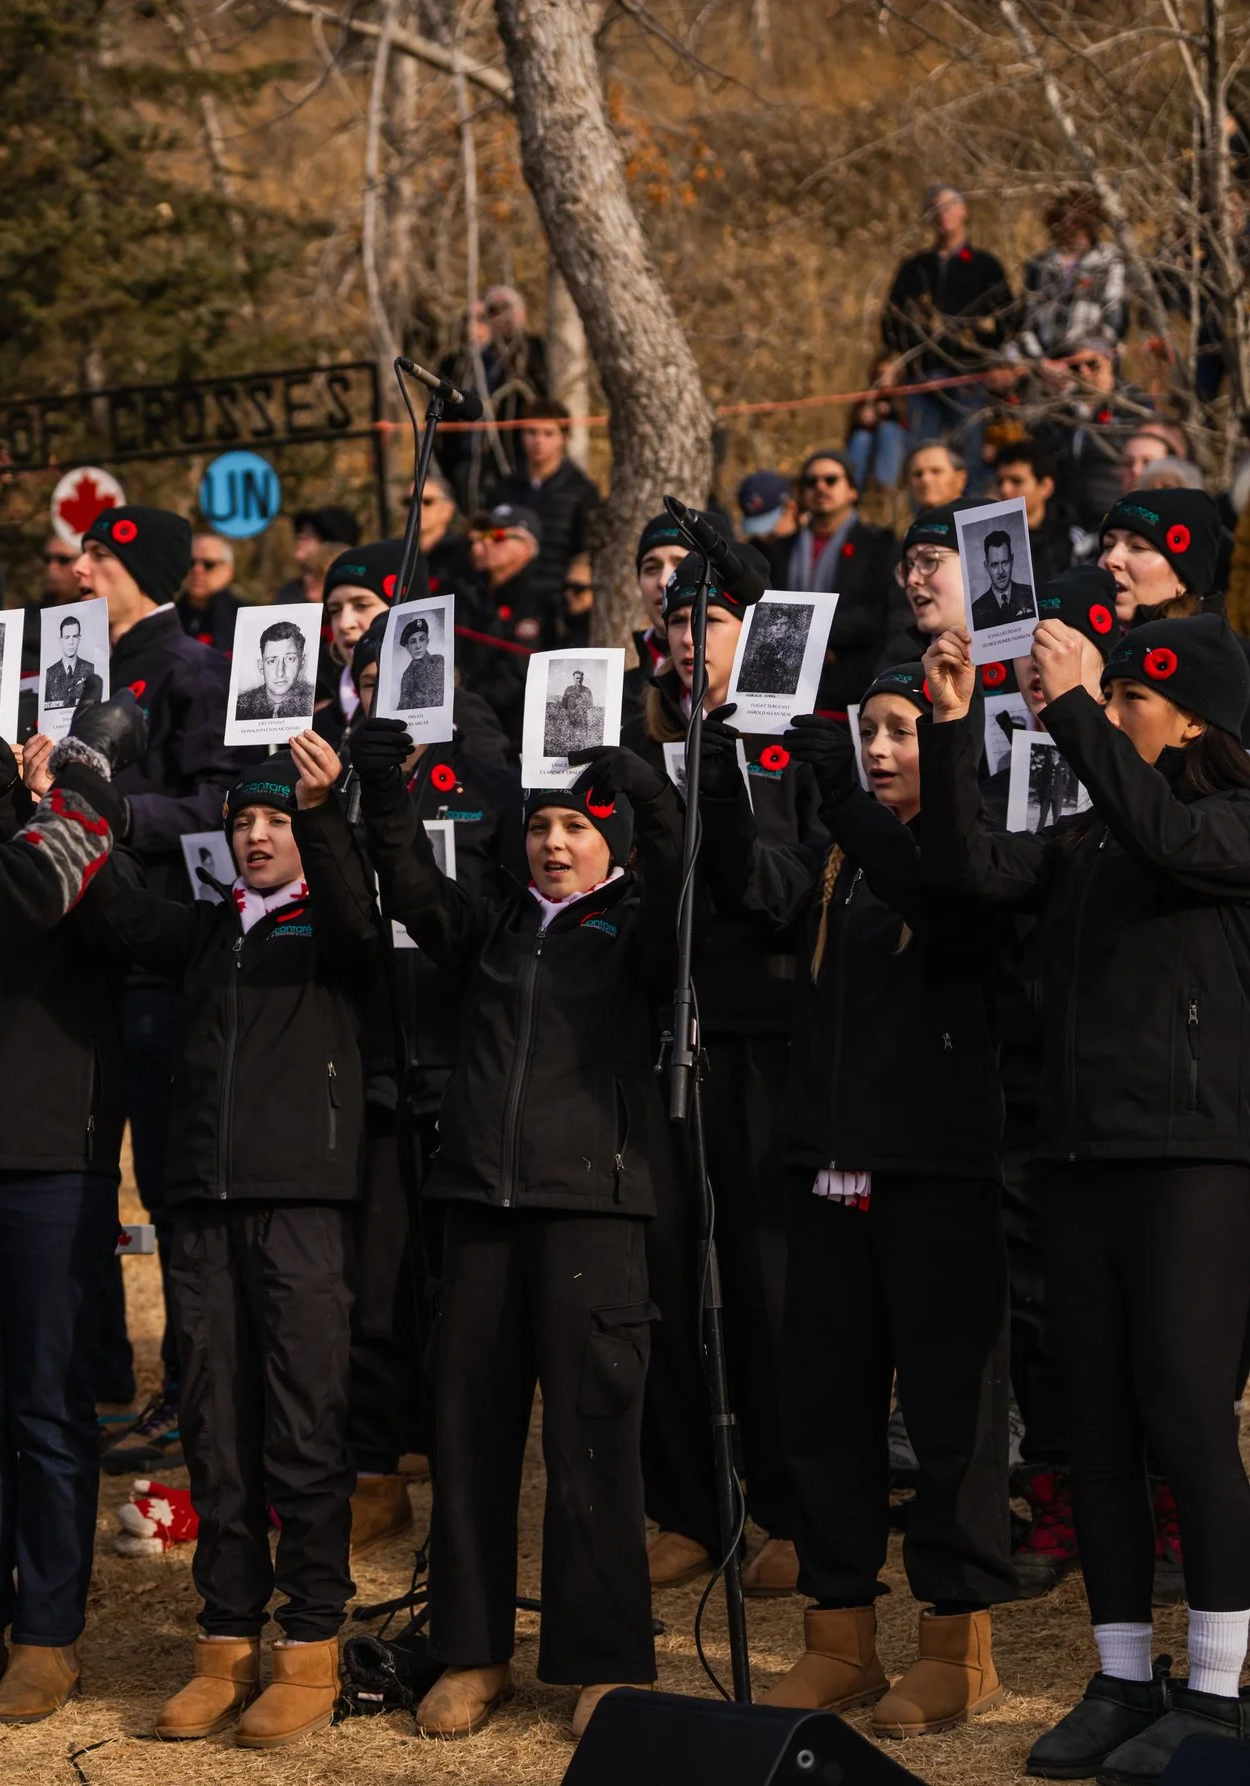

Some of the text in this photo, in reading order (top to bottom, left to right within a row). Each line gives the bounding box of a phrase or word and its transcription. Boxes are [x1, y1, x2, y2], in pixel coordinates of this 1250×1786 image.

[7, 371, 352, 463] OF CROSSES
[204, 469, 271, 523] UN
[981, 640, 997, 648] GEORGE
